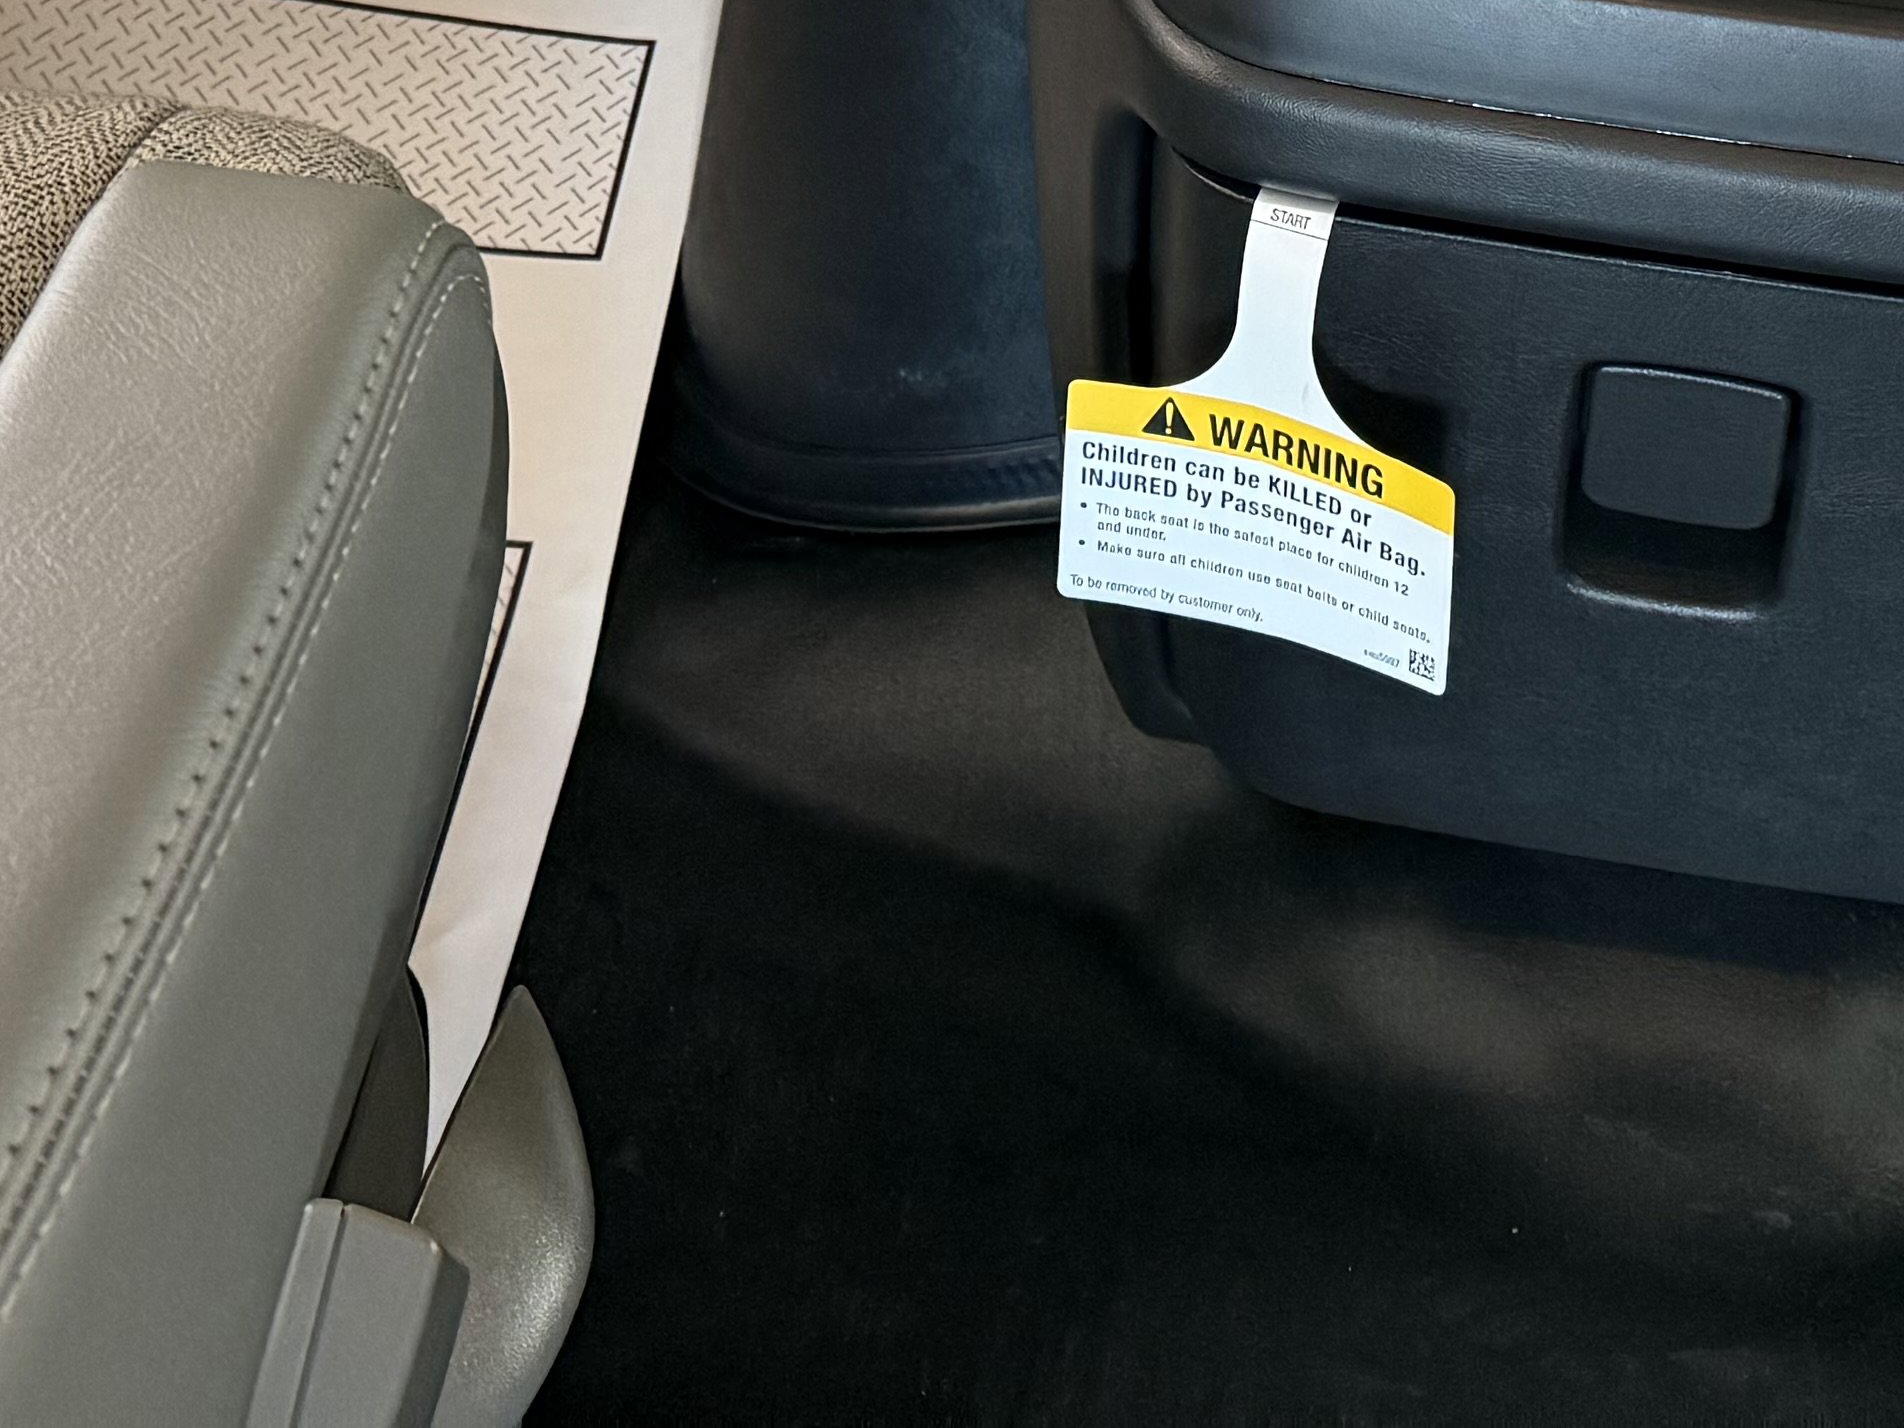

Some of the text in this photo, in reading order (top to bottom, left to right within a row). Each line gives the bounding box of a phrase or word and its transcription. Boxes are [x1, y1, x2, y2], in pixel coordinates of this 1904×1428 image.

[1270, 208, 1312, 230] START
[1082, 441, 1372, 527] Children can be KILLED or
[1209, 414, 1383, 499] WARNING
[1082, 466, 1426, 576] INJURED by Passenger Air Bag.
[1096, 502, 1409, 596] The back seat is the safest place for children 12
[1098, 521, 1166, 542] and under.
[1070, 573, 1264, 622] To be removed by customer only.
[1098, 540, 1430, 644] Make sure all children use seat belts or child seats.
